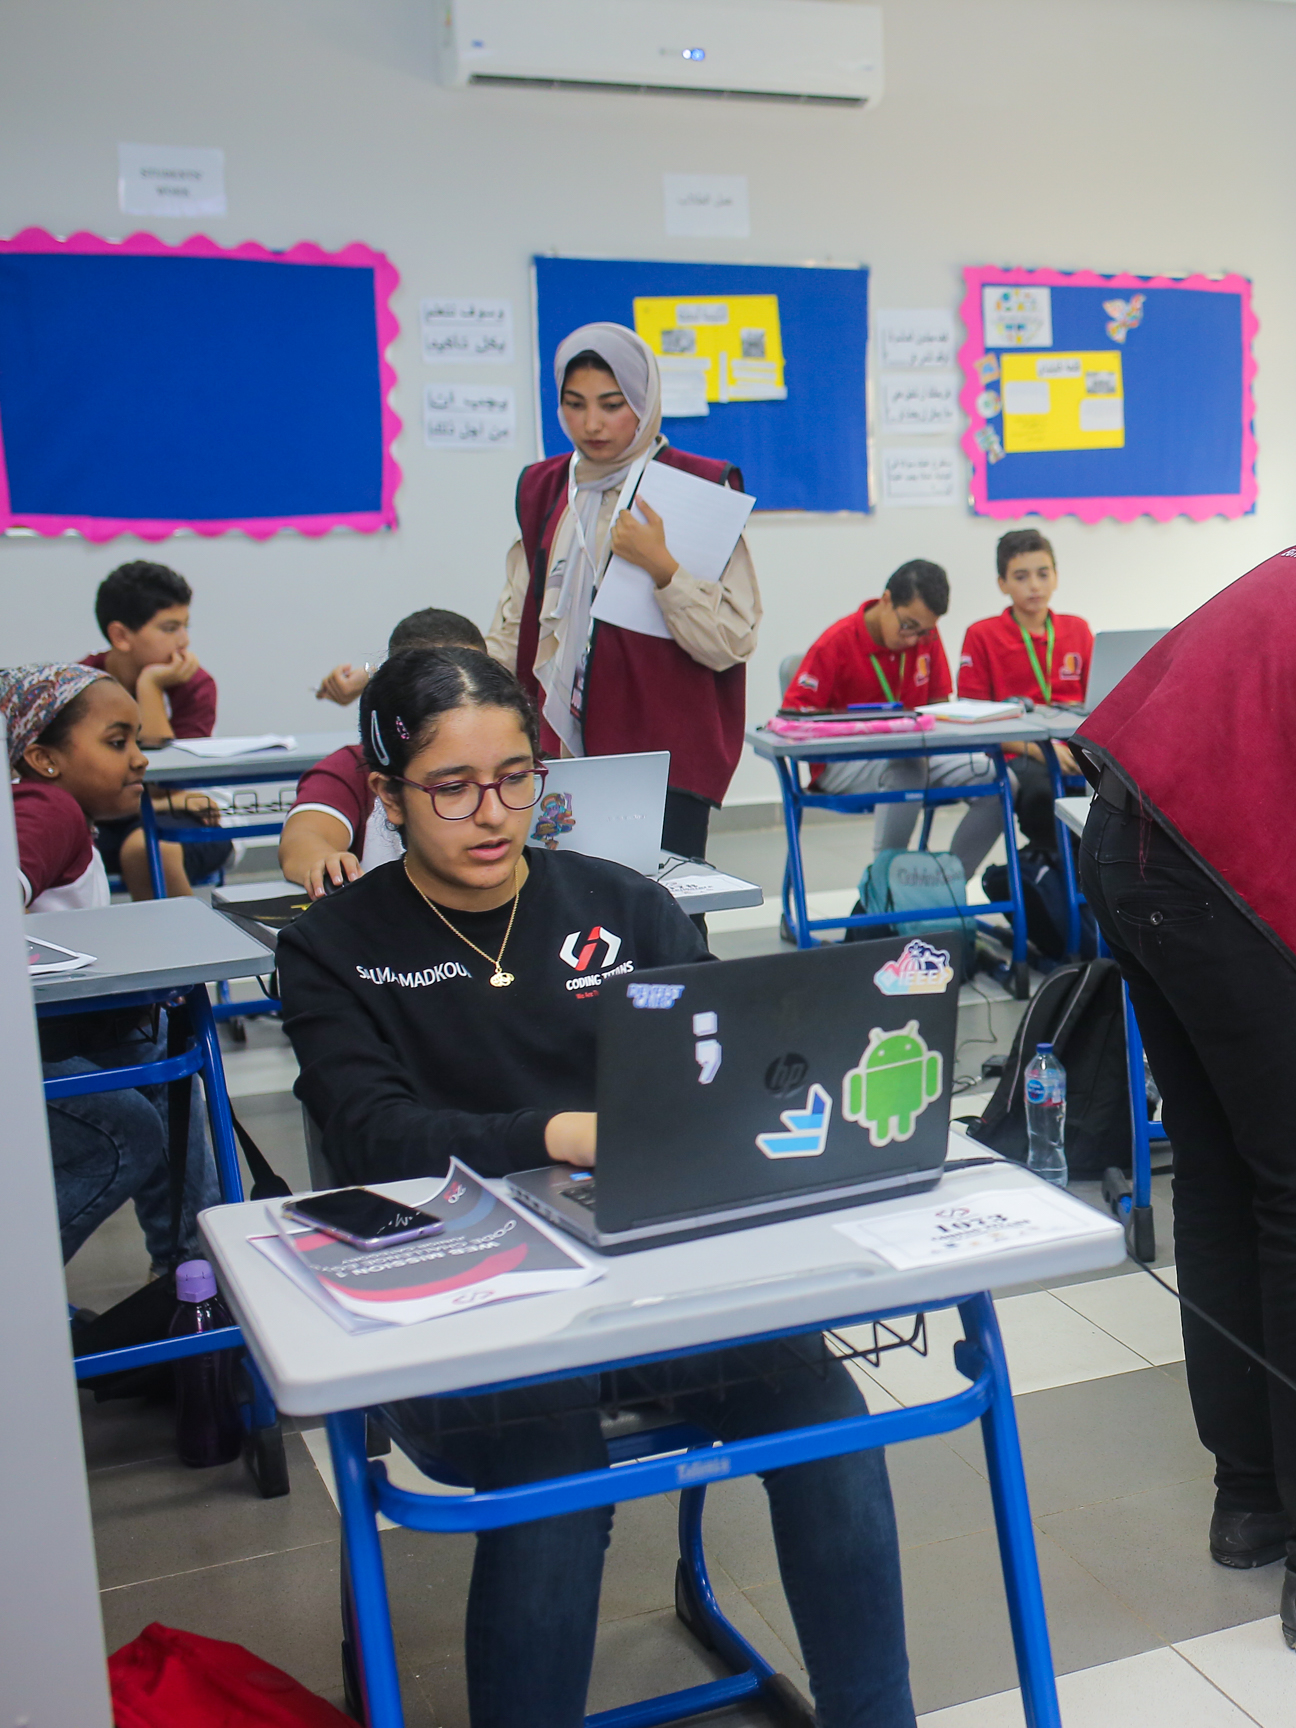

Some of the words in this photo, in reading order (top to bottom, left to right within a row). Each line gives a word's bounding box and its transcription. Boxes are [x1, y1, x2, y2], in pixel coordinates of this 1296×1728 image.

[565, 974, 602, 991] CODING
[899, 970, 940, 987] IEEE
[768, 1053, 807, 1098] hp
[471, 1219, 518, 1245] CODE
[361, 1241, 468, 1267] CHALLENGE
[448, 1240, 501, 1257] WEB
[352, 1250, 446, 1277] MISSION
